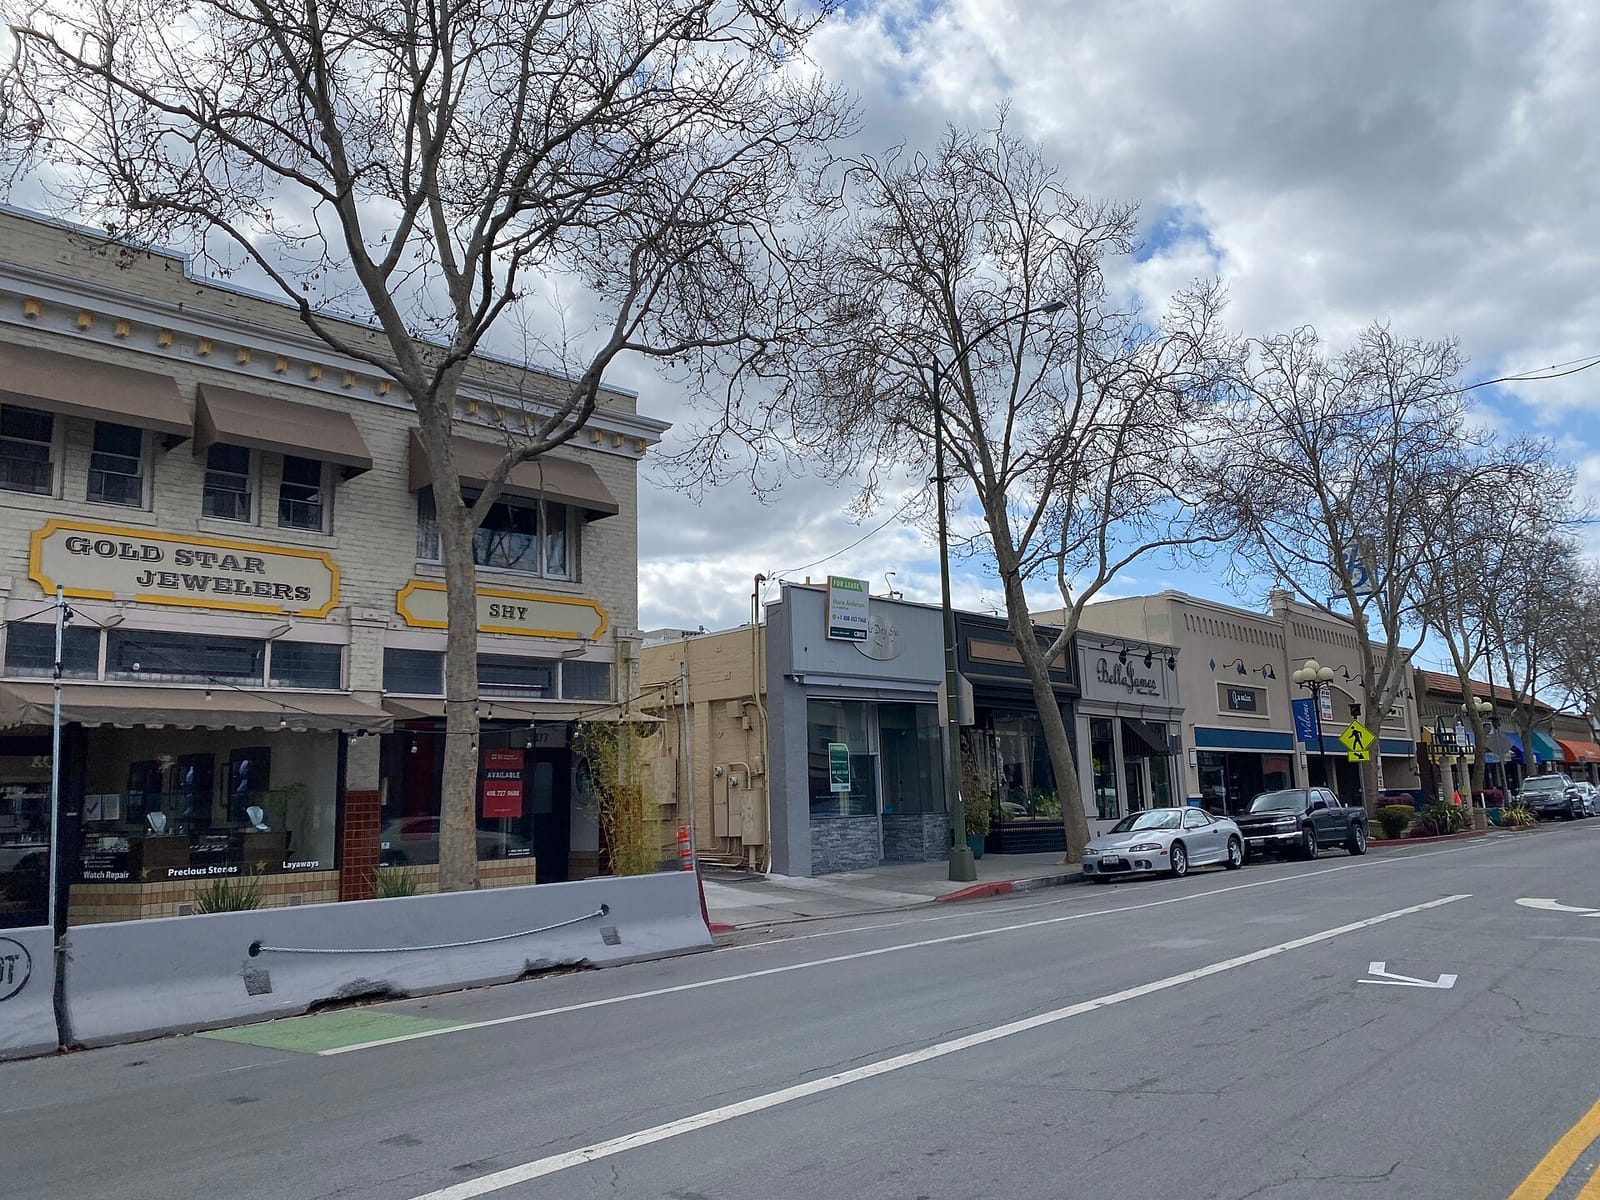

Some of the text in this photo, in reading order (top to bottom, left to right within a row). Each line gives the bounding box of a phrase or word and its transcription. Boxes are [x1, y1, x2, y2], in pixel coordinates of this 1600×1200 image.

[65, 536, 266, 574] GOLD STAR
[136, 569, 311, 601] JEWELERS
[489, 603, 529, 621] SHY
[1097, 657, 1157, 695] Bella James
[167, 866, 207, 877] Precious
[282, 859, 319, 869] Layaways
[83, 870, 130, 881] Watch Repair
